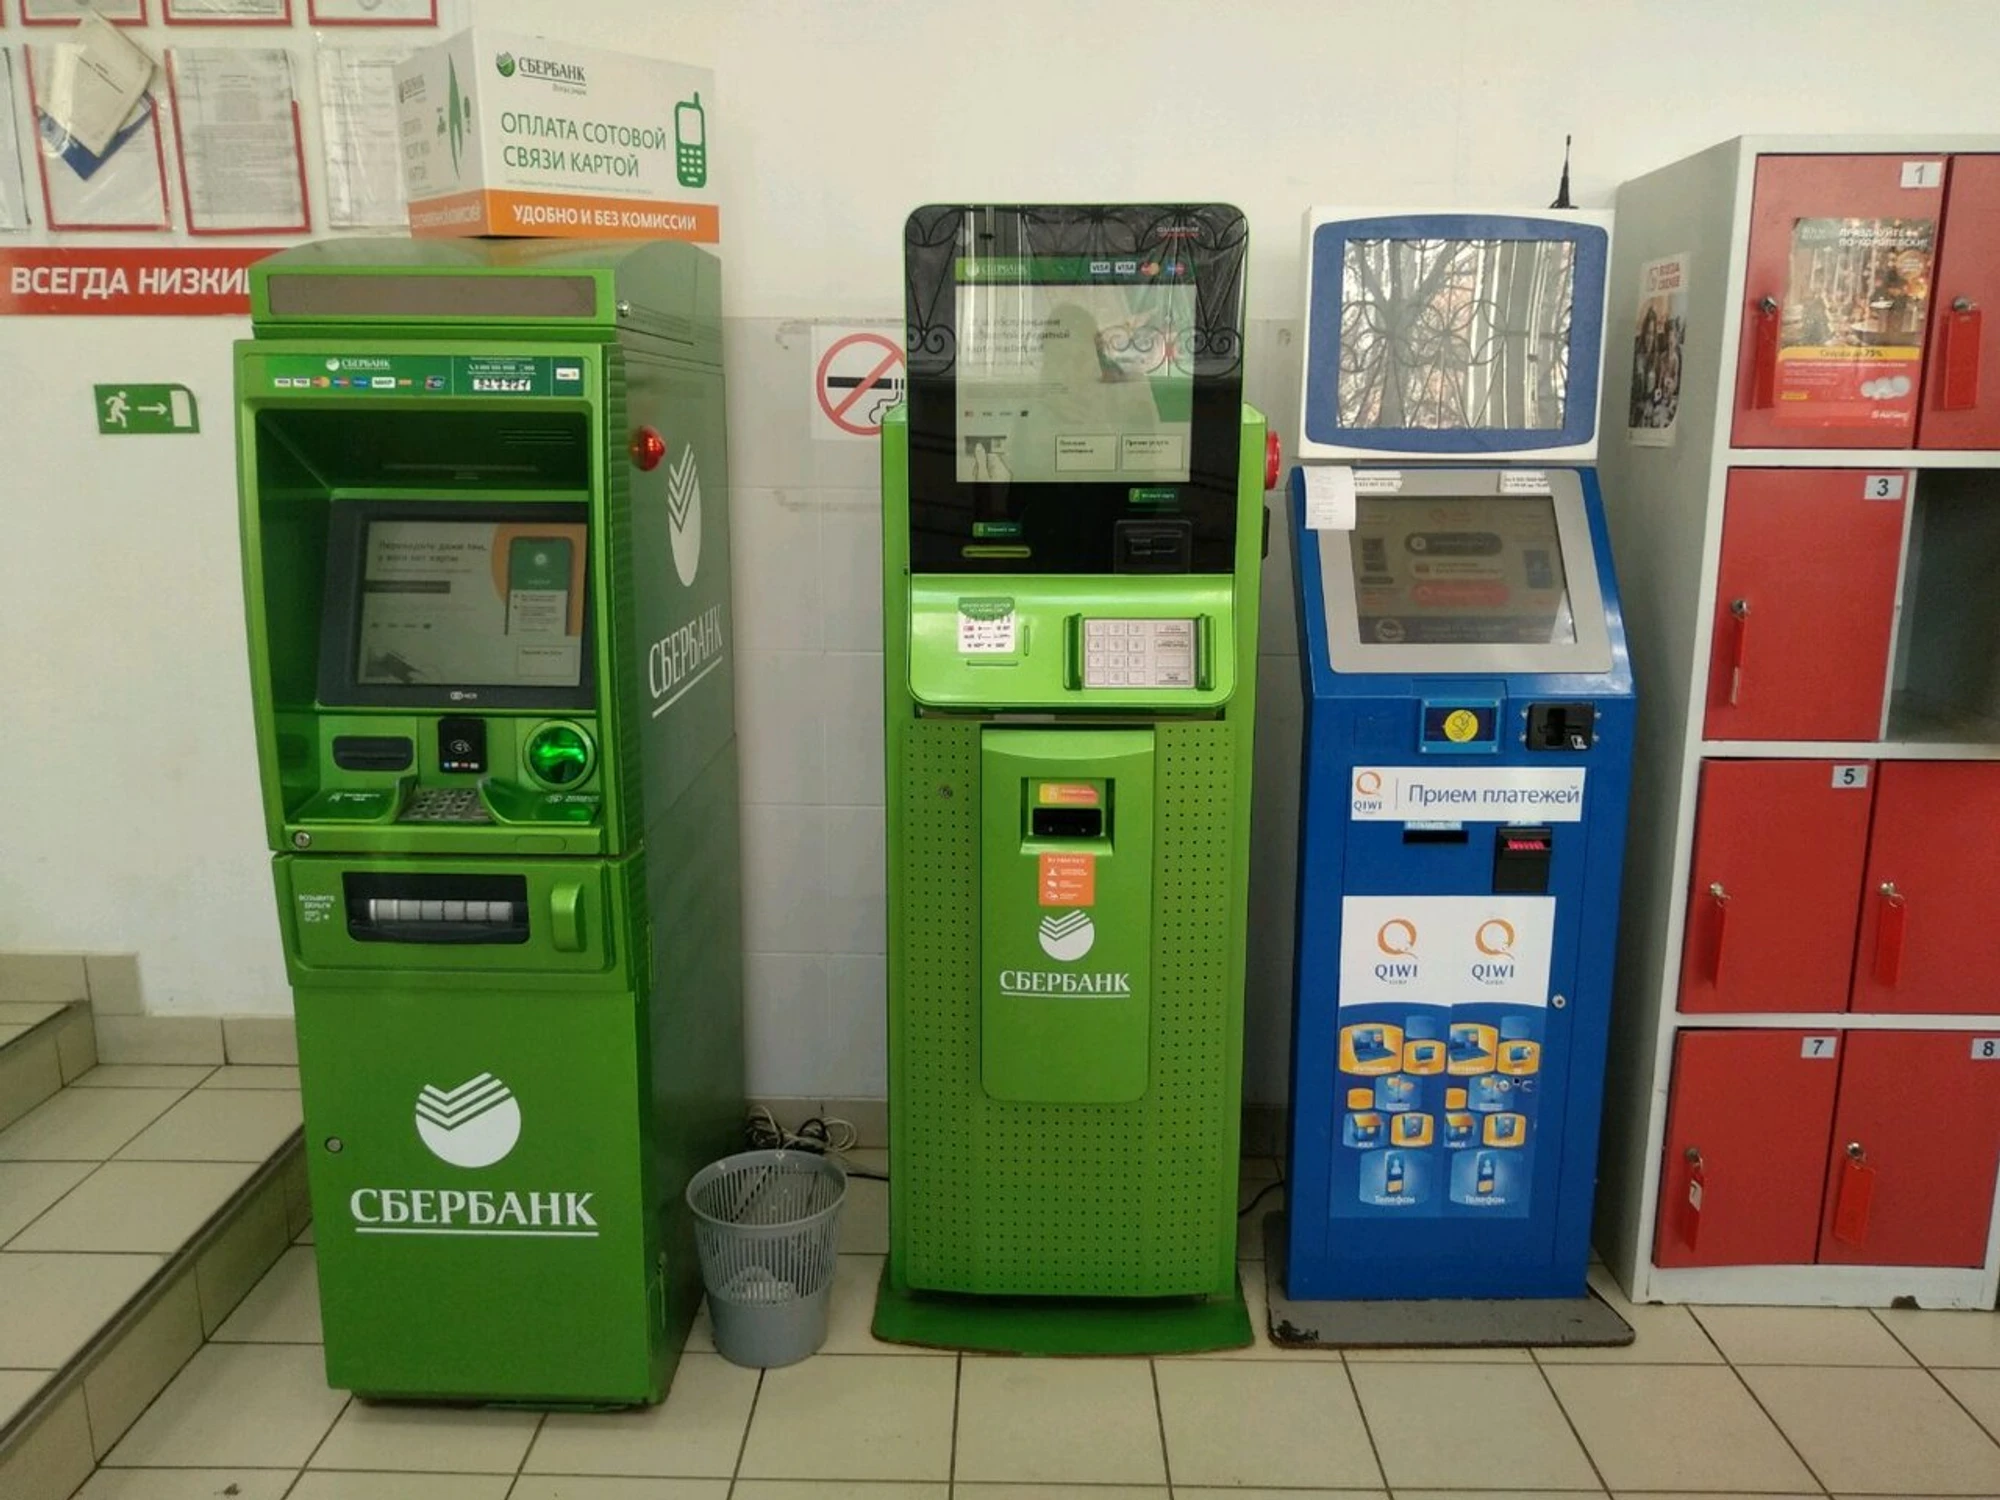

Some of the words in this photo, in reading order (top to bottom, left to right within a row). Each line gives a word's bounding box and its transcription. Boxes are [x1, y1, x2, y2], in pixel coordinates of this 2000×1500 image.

[518, 56, 586, 82] СБЕРБАНК
[501, 112, 578, 141] ОПЛАТА
[583, 121, 666, 151] СОТОВОЙ
[503, 145, 566, 171] СВЯЗИ
[571, 152, 639, 178] КАРТОЙ
[1913, 163, 1926, 185] 1
[512, 204, 578, 225] УДОБНО
[581, 209, 593, 224] И
[594, 209, 620, 228] БЕЗ
[621, 211, 697, 231] КОМИССИИ
[11, 266, 130, 300] ВСЕГДА
[1877, 478, 1889, 497] 3
[649, 604, 722, 699] СБЕРБАНК
[1843, 768, 1855, 785] 5
[1354, 800, 1382, 811] QIWI
[1408, 784, 1477, 806] Прием
[1483, 786, 1580, 804] платежей
[1000, 970, 1131, 994] СБЕРБАНК
[1375, 964, 1418, 982] QIWI
[1471, 964, 1514, 982] QIWI
[1813, 1040, 1824, 1055] 7
[1982, 1041, 1994, 1056] 8
[350, 1188, 598, 1227] СБЕРБАНК
